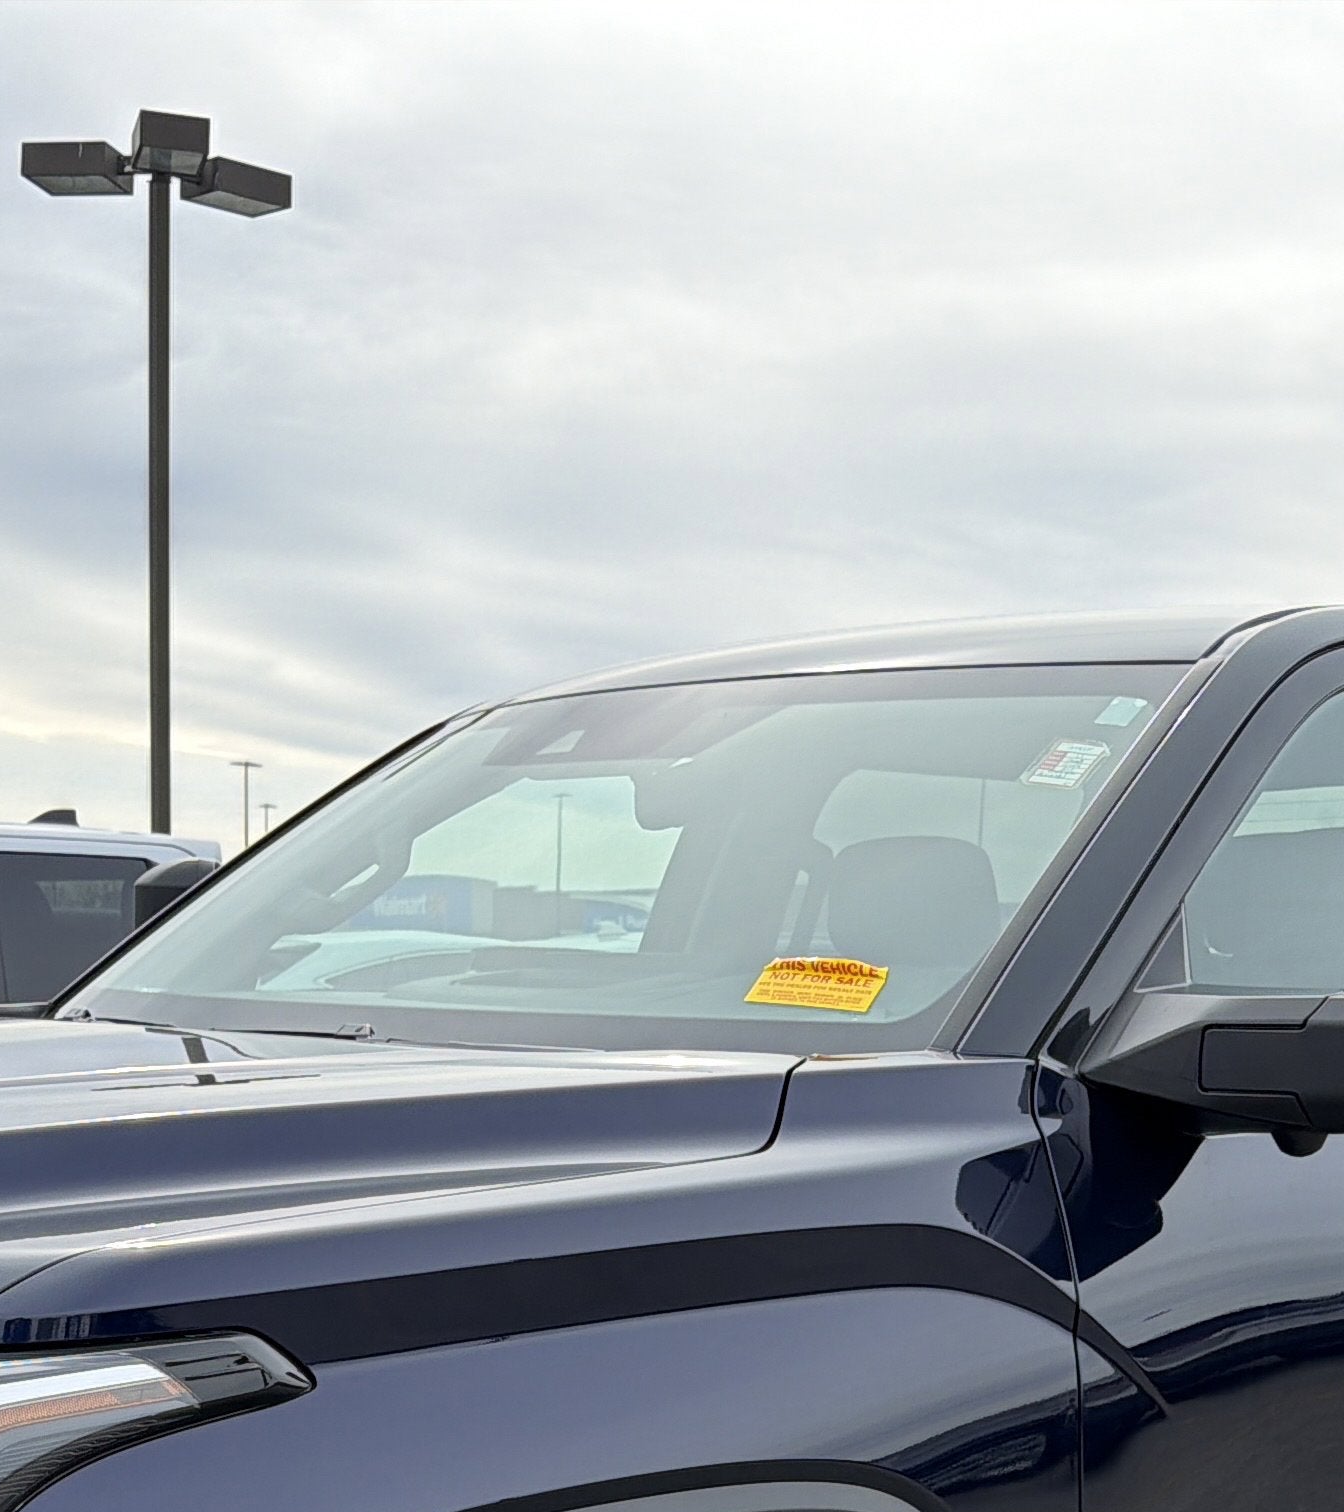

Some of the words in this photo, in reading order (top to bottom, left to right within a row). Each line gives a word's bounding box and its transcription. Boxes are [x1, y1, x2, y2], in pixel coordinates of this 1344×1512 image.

[811, 960, 880, 978] VEHICLE
[769, 971, 801, 981] NOT
[801, 973, 833, 984] FOR
[834, 976, 875, 988] SALE
